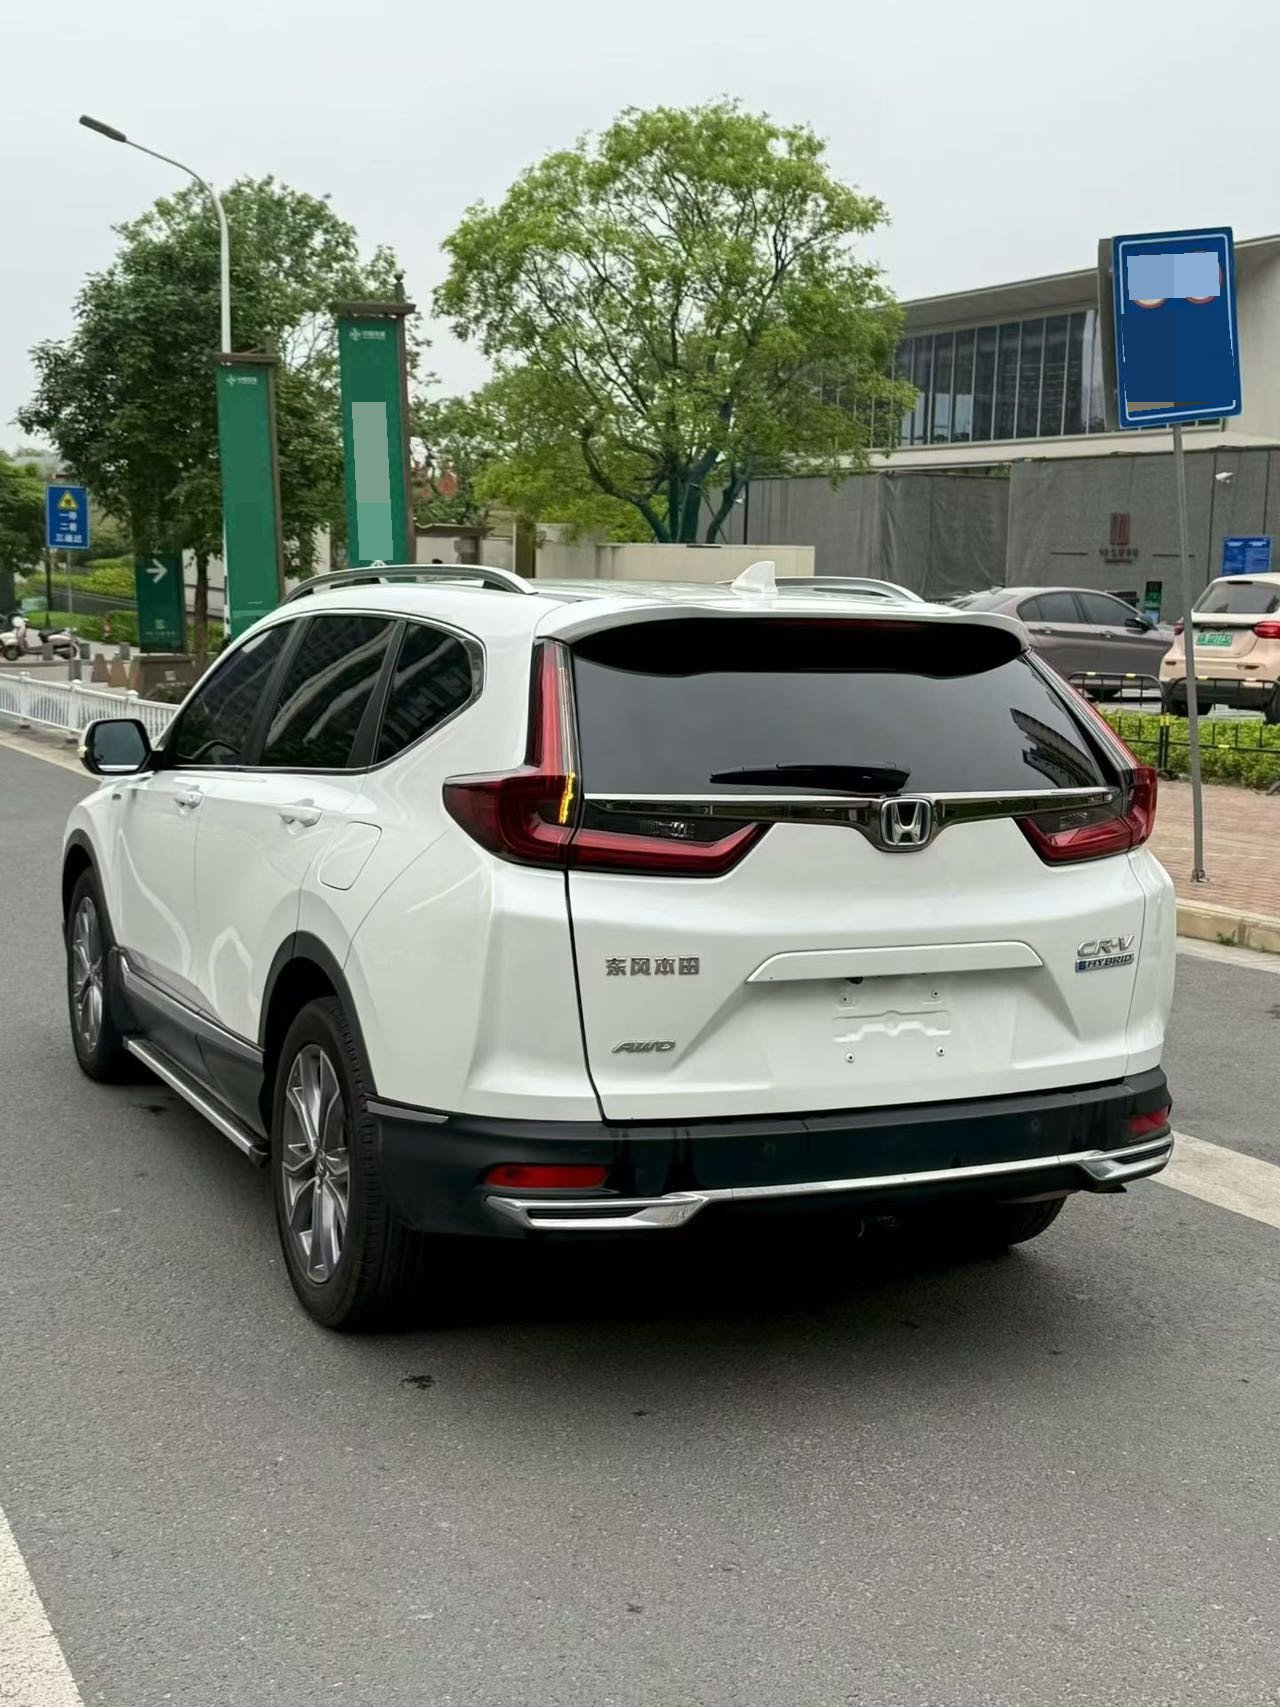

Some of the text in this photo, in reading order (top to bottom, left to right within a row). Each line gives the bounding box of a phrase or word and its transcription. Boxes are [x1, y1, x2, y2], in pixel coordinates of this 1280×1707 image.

[1077, 934, 1135, 957] CR-V
[605, 957, 700, 977] 东风本田
[1087, 953, 1132, 968] HYBRID
[611, 1040, 676, 1054] AWD
